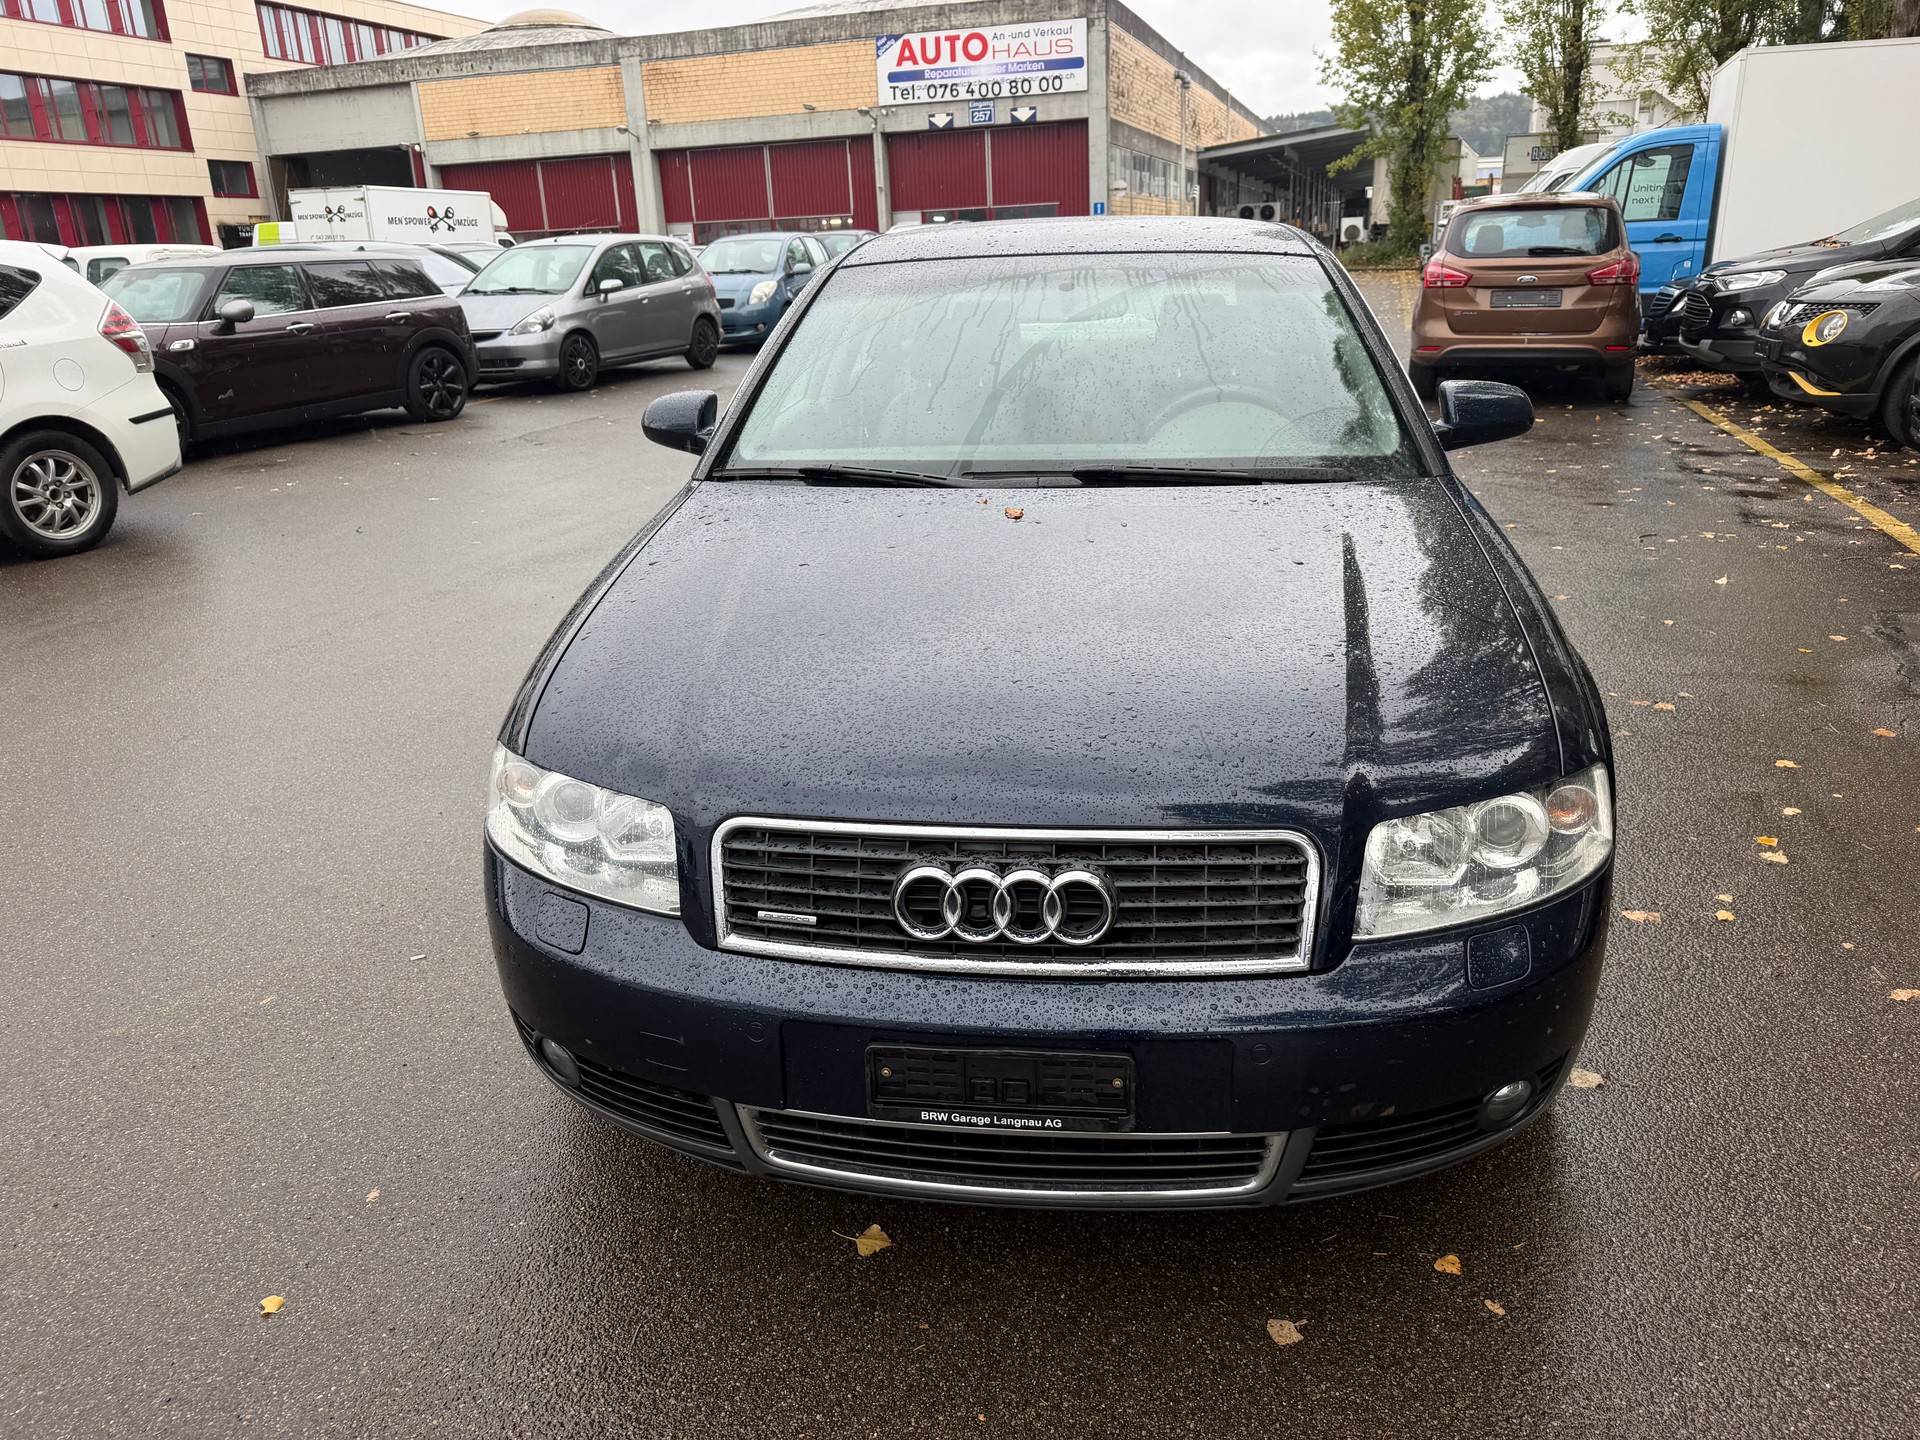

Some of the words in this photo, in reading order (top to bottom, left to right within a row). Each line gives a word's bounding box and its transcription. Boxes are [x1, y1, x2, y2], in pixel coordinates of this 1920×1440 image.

[992, 32, 1006, 41] An
[1033, 25, 1073, 37] Verkauf
[896, 32, 989, 67] AUTO
[992, 38, 1074, 60] HAUS
[1008, 62, 1045, 73] Marken
[889, 84, 921, 101] Tel.
[926, 83, 960, 99] 076
[965, 81, 1002, 98] 400
[1009, 79, 1032, 95] 80
[1038, 76, 1063, 93] 00
[973, 111, 991, 122] 257
[1631, 196, 1654, 204] next
[763, 913, 810, 923] quattro
[921, 1111, 948, 1121] BRW
[951, 1113, 991, 1125] Garage
[993, 1115, 1042, 1128] Langnau
[1044, 1119, 1062, 1128] AG
